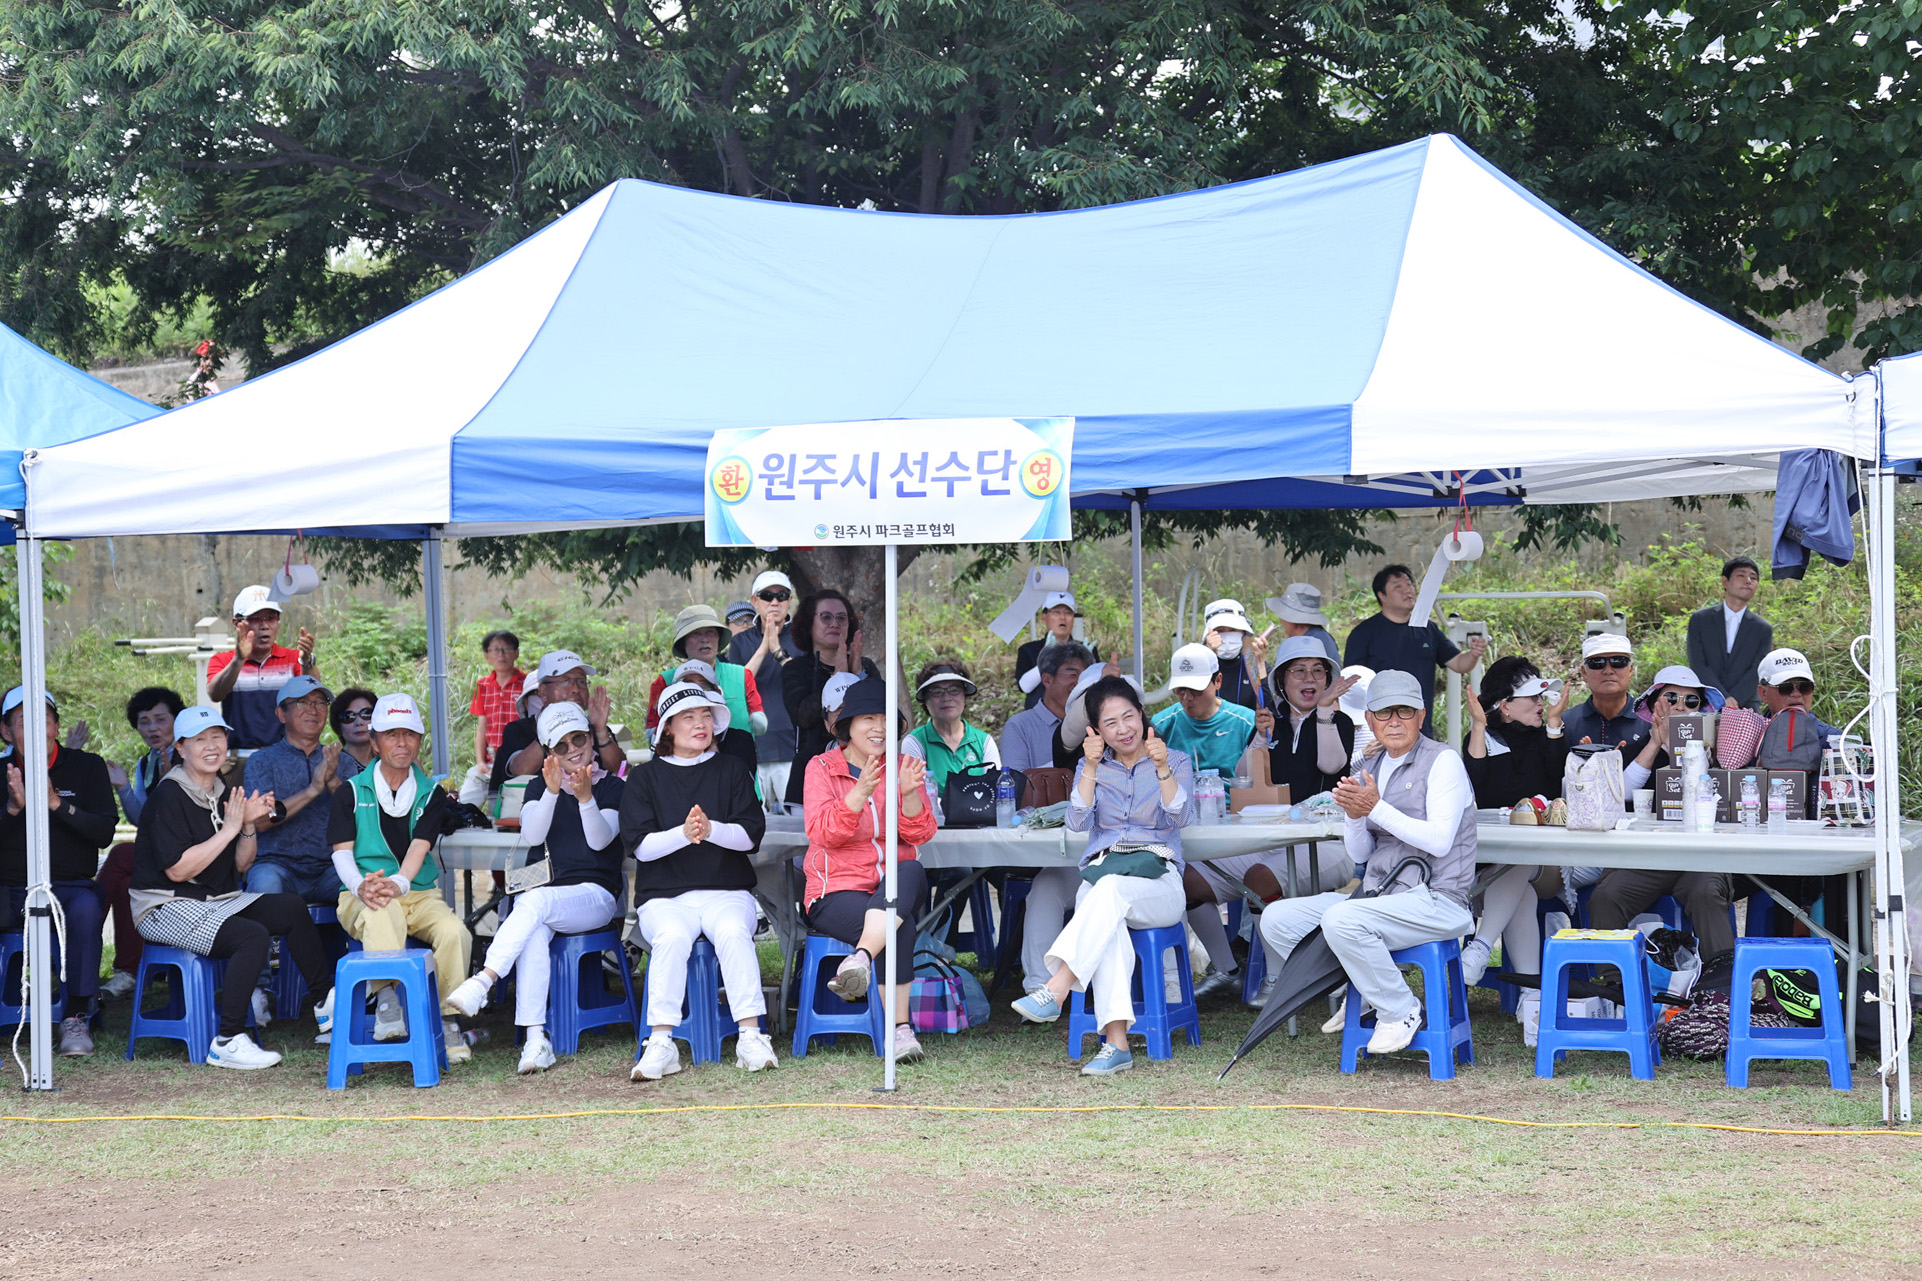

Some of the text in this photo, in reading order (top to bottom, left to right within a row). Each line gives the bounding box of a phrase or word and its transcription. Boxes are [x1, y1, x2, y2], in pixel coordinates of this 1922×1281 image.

[718, 449, 1052, 501] 환 원주시 선수단 영
[832, 523, 955, 539] 원주시 파크골프협회
[1775, 657, 1803, 665] DAVID
